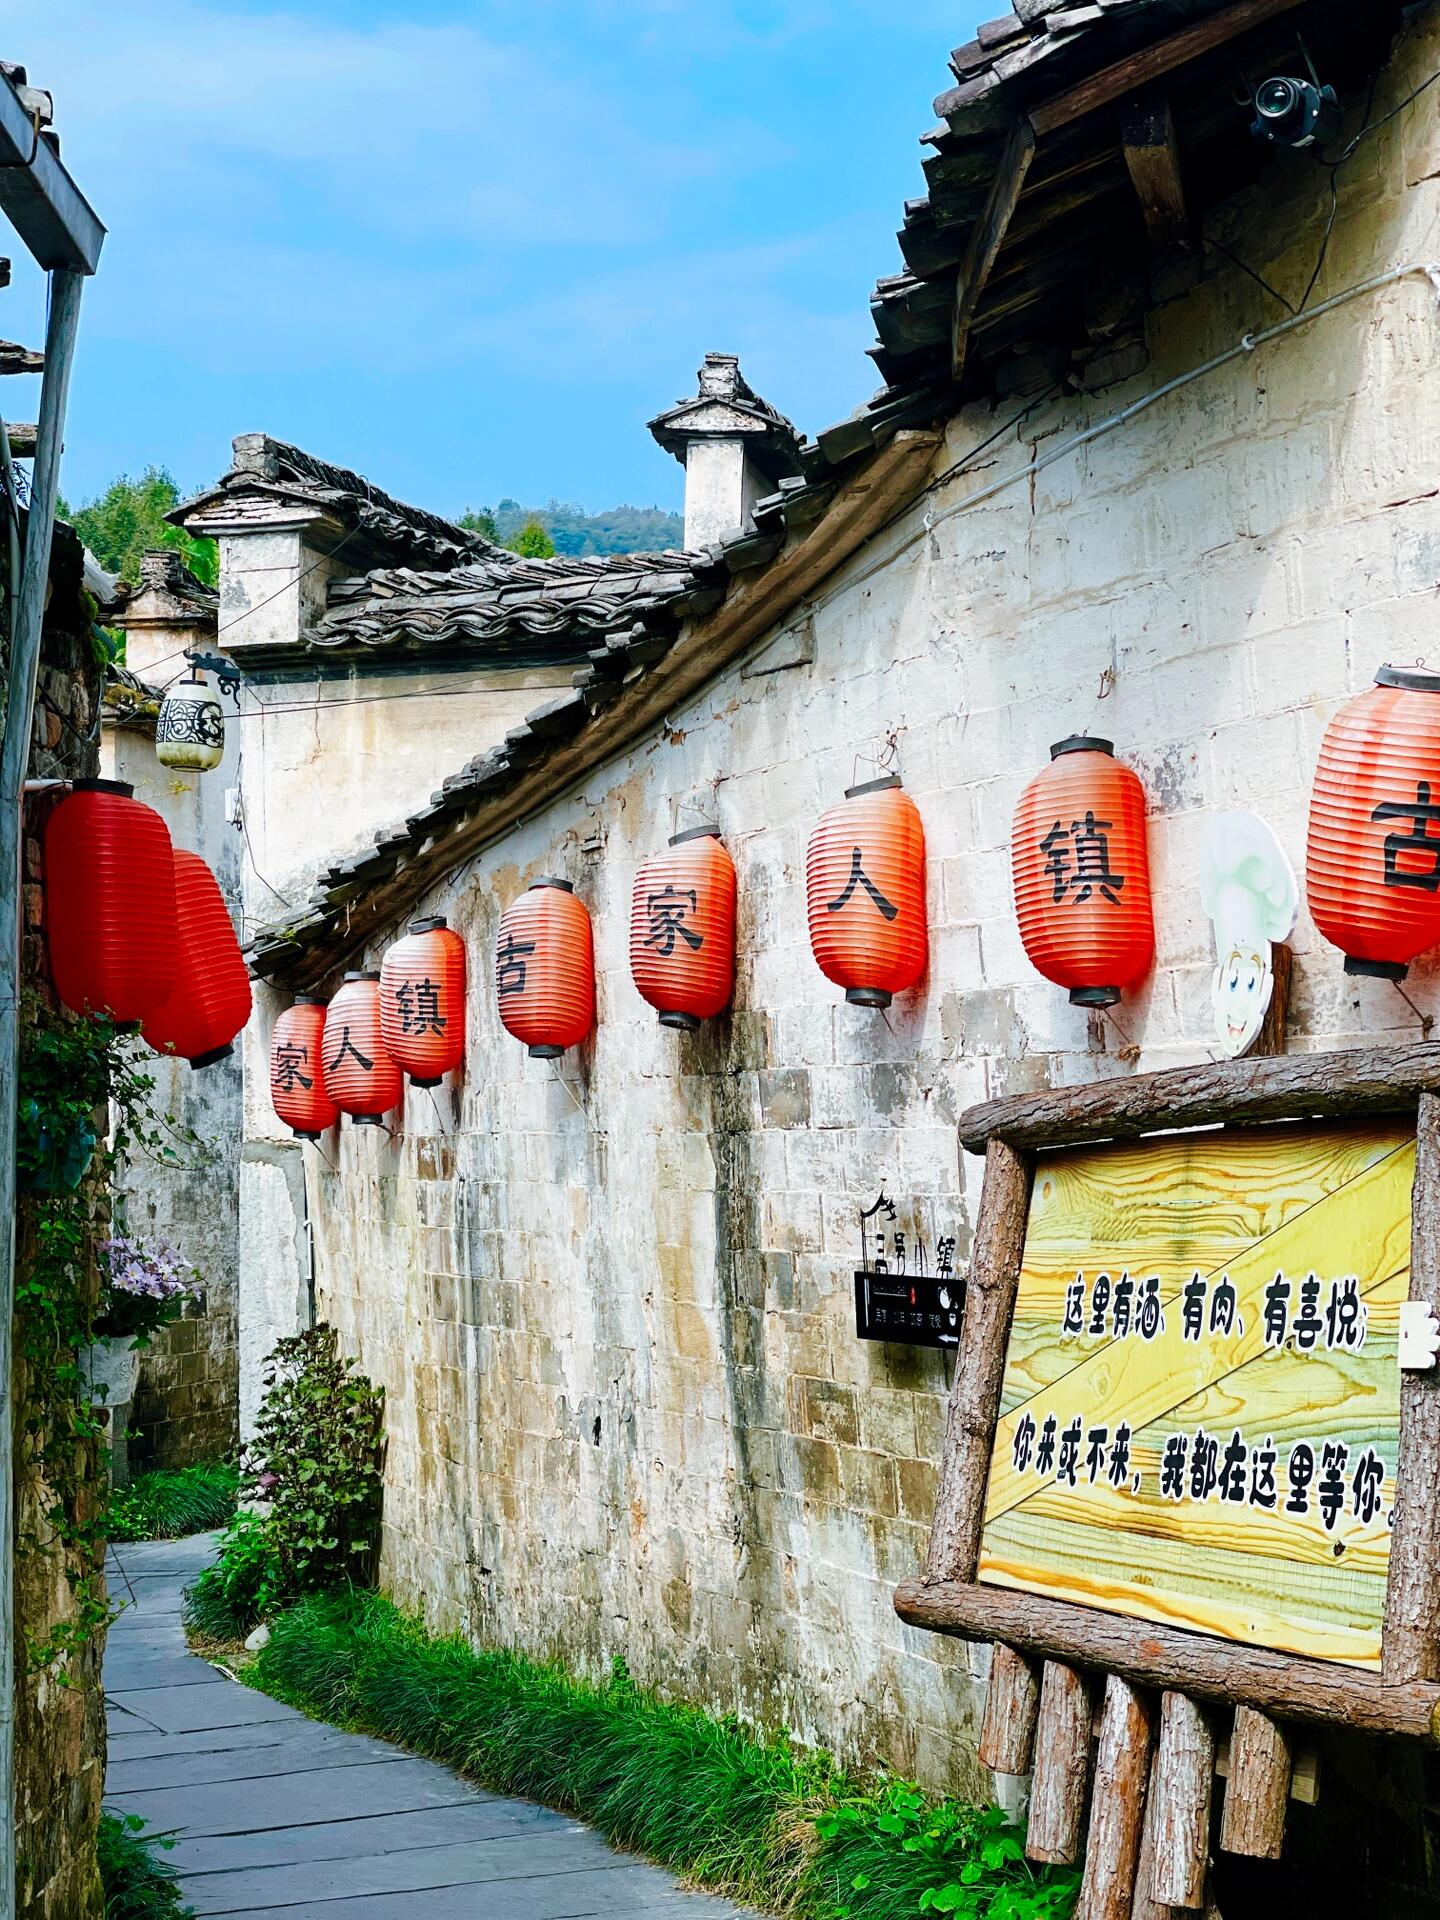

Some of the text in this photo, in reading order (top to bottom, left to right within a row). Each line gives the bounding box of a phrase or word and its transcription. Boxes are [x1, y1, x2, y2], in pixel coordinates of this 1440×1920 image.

[1039, 811, 1125, 907] 镇
[1371, 780, 1440, 893] 古
[827, 847, 899, 922] 人
[643, 885, 705, 956] 家
[497, 934, 536, 994] 古
[395, 977, 447, 1038] 镇
[274, 1042, 313, 1093] 家
[328, 1026, 374, 1071] 人
